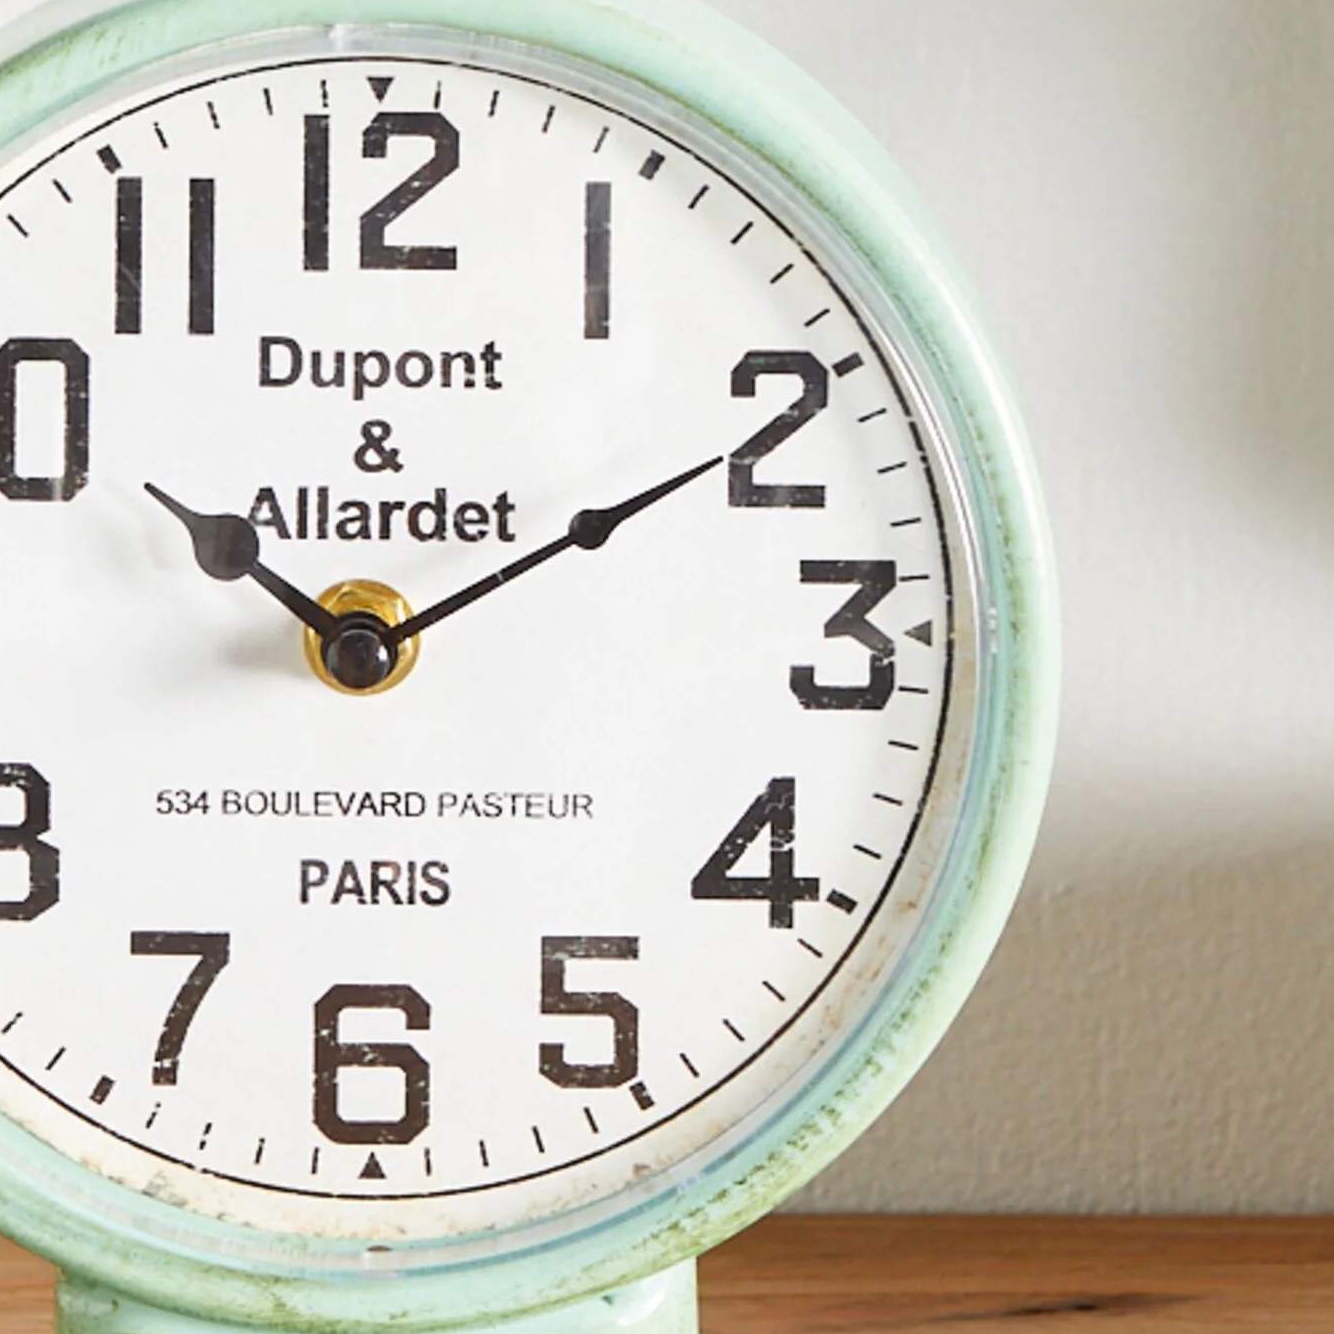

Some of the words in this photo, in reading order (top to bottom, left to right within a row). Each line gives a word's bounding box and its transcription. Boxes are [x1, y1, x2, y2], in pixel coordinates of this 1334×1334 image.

[114, 177, 216, 335] 11
[303, 111, 460, 272] 12
[584, 181, 612, 340] 1
[258, 335, 504, 401] Dupont
[727, 350, 830, 509] 2
[247, 485, 517, 544] Allardet
[353, 419, 405, 473] &
[788, 559, 897, 711] 3
[155, 789, 210, 816] 534
[221, 789, 427, 819] BOULEVARD
[437, 791, 595, 821] PASTEUR
[690, 776, 820, 930] 4
[298, 858, 452, 907] PARIS
[129, 930, 231, 1087] 7
[312, 983, 431, 1146] 6
[538, 935, 639, 1090] 5
